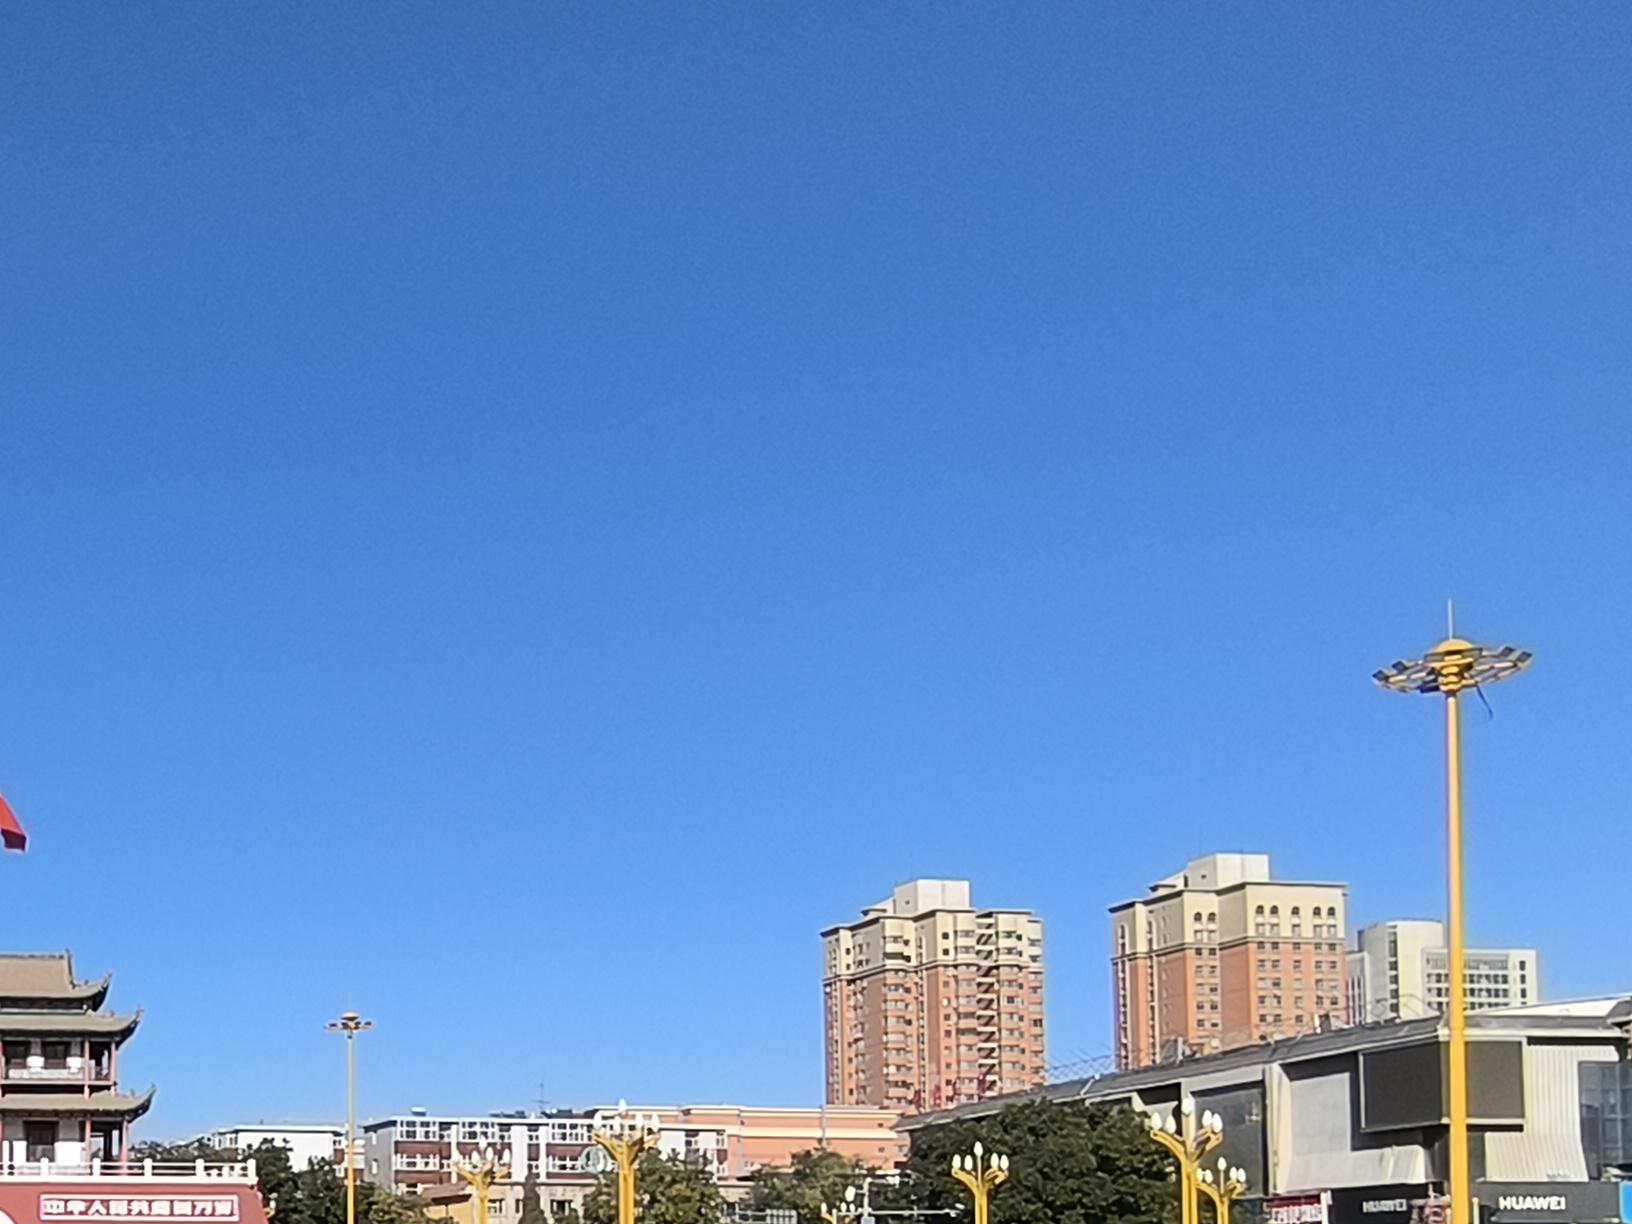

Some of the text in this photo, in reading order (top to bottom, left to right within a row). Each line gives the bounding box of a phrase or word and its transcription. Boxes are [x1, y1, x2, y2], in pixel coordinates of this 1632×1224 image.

[44, 1200, 232, 1215] 中华人民共和国万岁
[1498, 1196, 1566, 1210] HUAWEI
